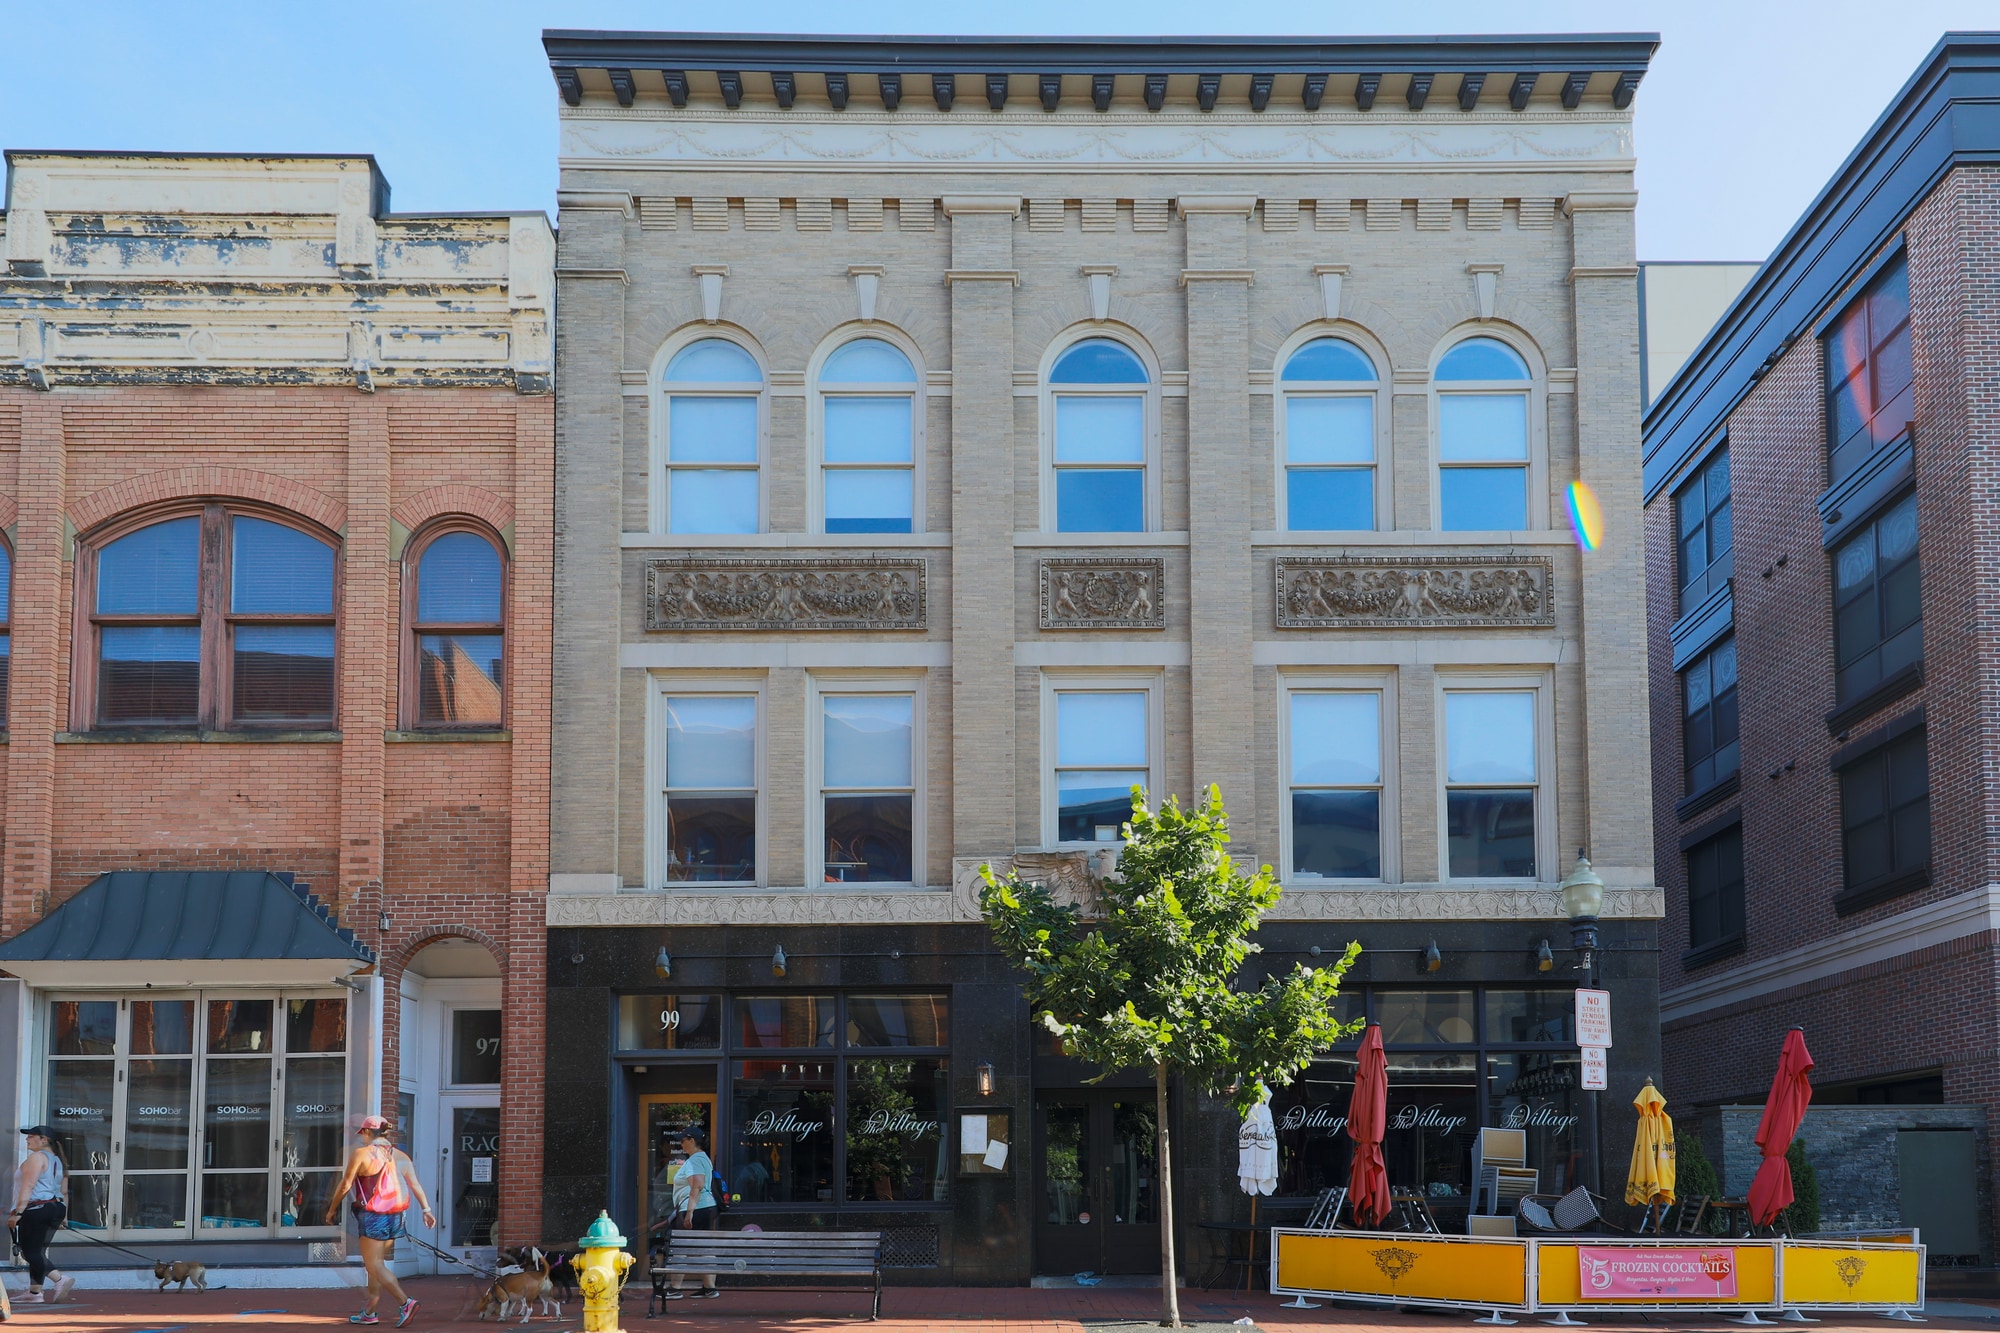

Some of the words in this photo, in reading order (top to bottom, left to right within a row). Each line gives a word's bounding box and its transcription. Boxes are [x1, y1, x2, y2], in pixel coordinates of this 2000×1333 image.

[1587, 996, 1599, 1005] NO
[660, 1010, 680, 1030] 99
[476, 1038, 500, 1056] 97
[1584, 1060, 1604, 1068] PARKING
[743, 1119, 769, 1136] The
[754, 1107, 824, 1142] Village
[858, 1119, 882, 1135] The
[868, 1106, 937, 1142] Village
[1276, 1115, 1300, 1130] The
[1388, 1114, 1413, 1130] The
[1400, 1103, 1466, 1136] Village
[1500, 1113, 1524, 1129] The
[1510, 1102, 1578, 1136] Village
[1582, 1255, 1612, 1290] $5
[1612, 1262, 1658, 1273] FROZEN
[1662, 1262, 1730, 1274] COCKTAILS
